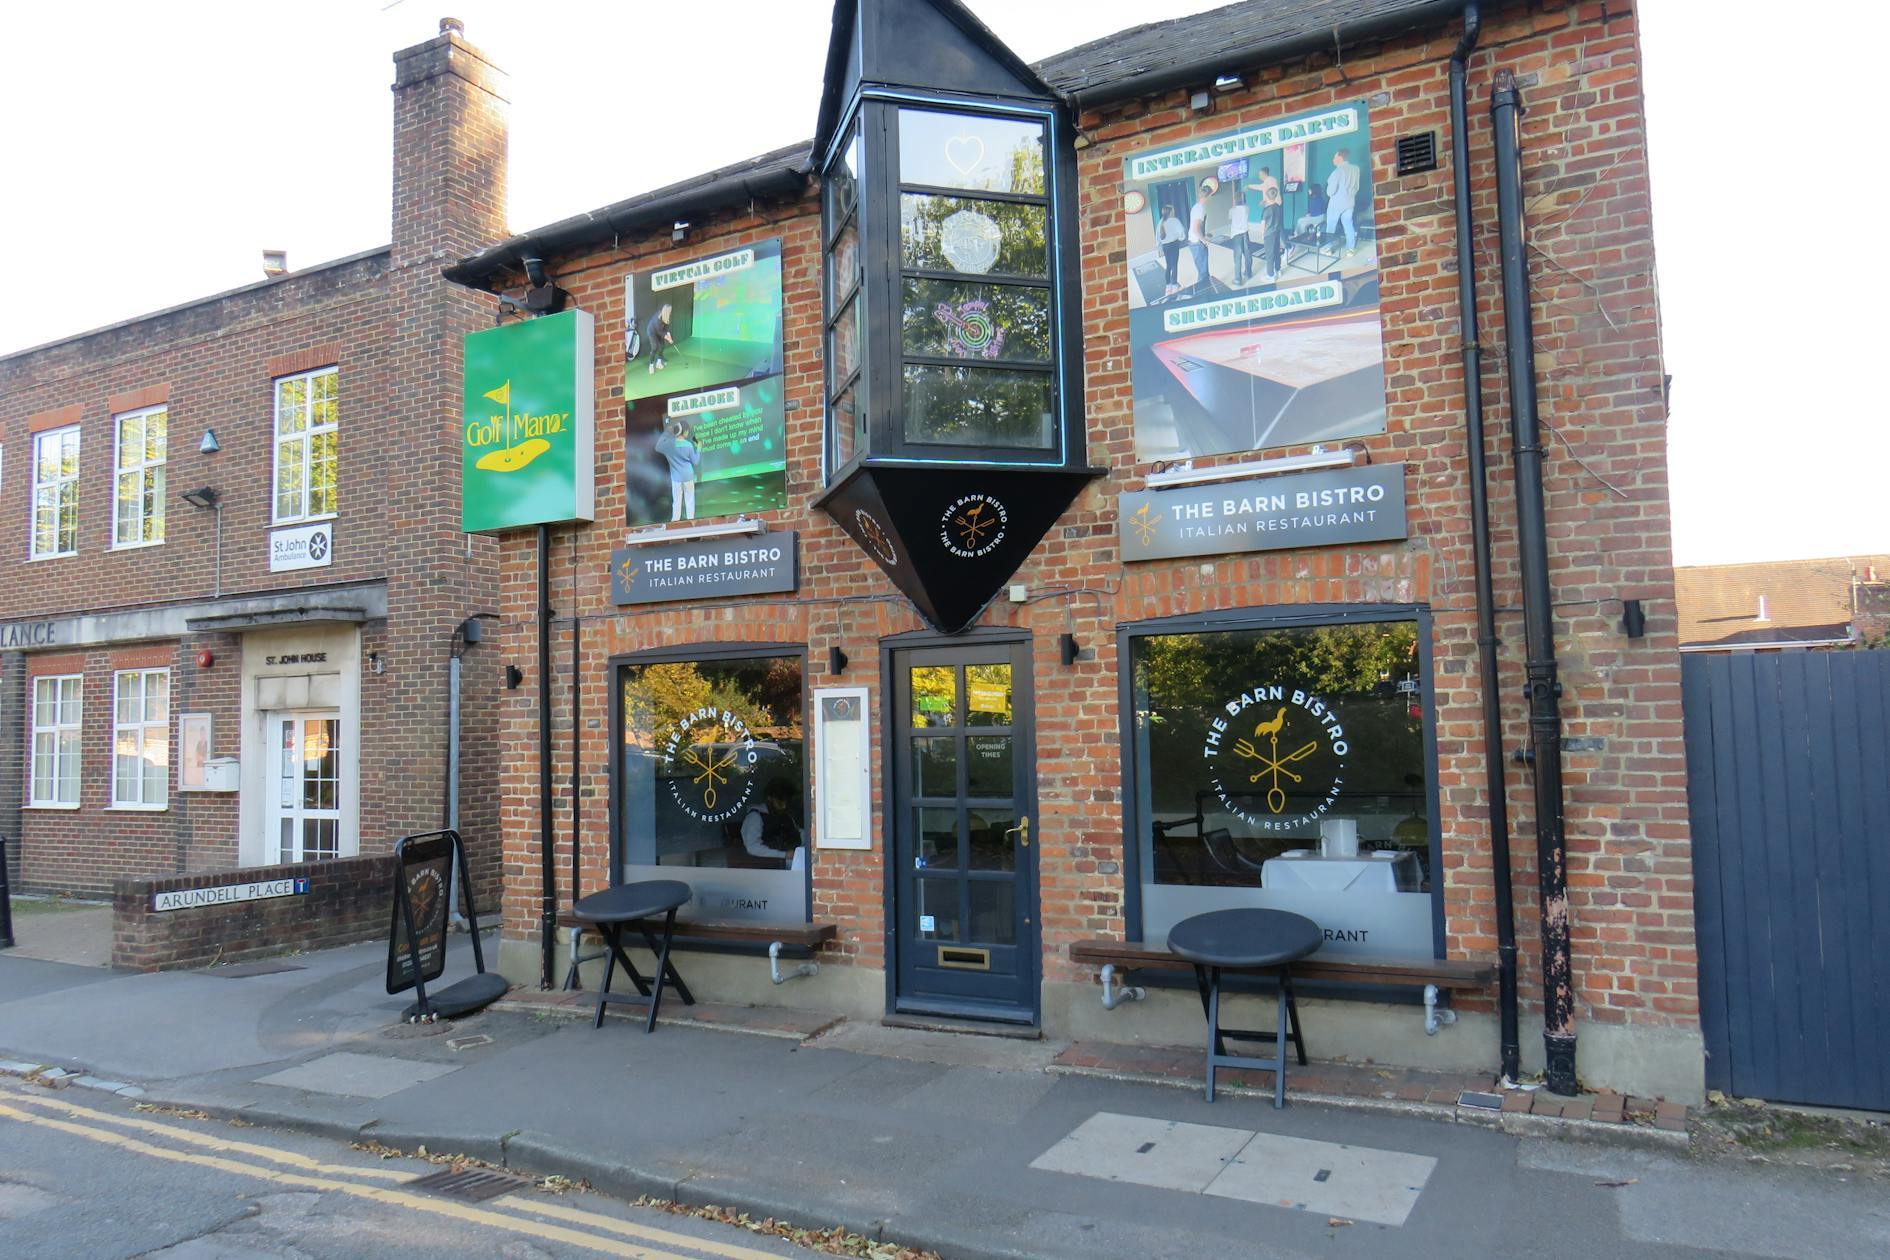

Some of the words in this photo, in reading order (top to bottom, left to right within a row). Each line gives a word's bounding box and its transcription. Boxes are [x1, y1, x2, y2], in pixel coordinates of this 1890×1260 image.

[1137, 131, 1273, 175] INTERACTIVE
[1278, 113, 1351, 141] DARTS
[655, 263, 710, 286] VIRTUAL
[713, 252, 750, 273] GOLF
[1169, 285, 1336, 326] SHUFFLEBOARD
[671, 390, 736, 414] KARAOKE
[467, 415, 504, 447] Golf
[942, 504, 957, 522] THE
[957, 494, 984, 506] BARN
[986, 496, 1008, 523] BISTRO
[1171, 502, 1215, 521] THE
[1222, 494, 1287, 516] BARN
[1295, 484, 1385, 509] BISTRO
[1180, 522, 1248, 539] ITALIAN
[1256, 510, 1377, 532] RESTAURANT
[285, 538, 307, 552] John
[940, 531, 952, 548] THE
[950, 546, 975, 558] BARN
[977, 532, 1005, 557] BISTRO
[645, 558, 673, 573] THE
[677, 553, 719, 570] BARN
[724, 547, 781, 566] BISTRO
[649, 575, 694, 588] ITALIAN
[698, 567, 776, 584] RESTAURANT
[279, 655, 299, 664] JOHN
[301, 652, 327, 663] HOUSE
[665, 731, 681, 764] THE
[680, 707, 717, 731] BARN
[721, 710, 758, 764] BISTRO
[1204, 716, 1228, 759] THE
[1225, 685, 1283, 717] BARN
[1291, 689, 1348, 756] BISTRO
[976, 743, 1006, 751] OPENING
[668, 780, 698, 818] ITALIAN
[701, 780, 754, 823] RESTAURANT
[1211, 778, 1256, 825] ITALIAN
[1264, 776, 1344, 831] RESTAURANT
[161, 887, 241, 908] ARUNDELL
[249, 881, 291, 897] PLACE
